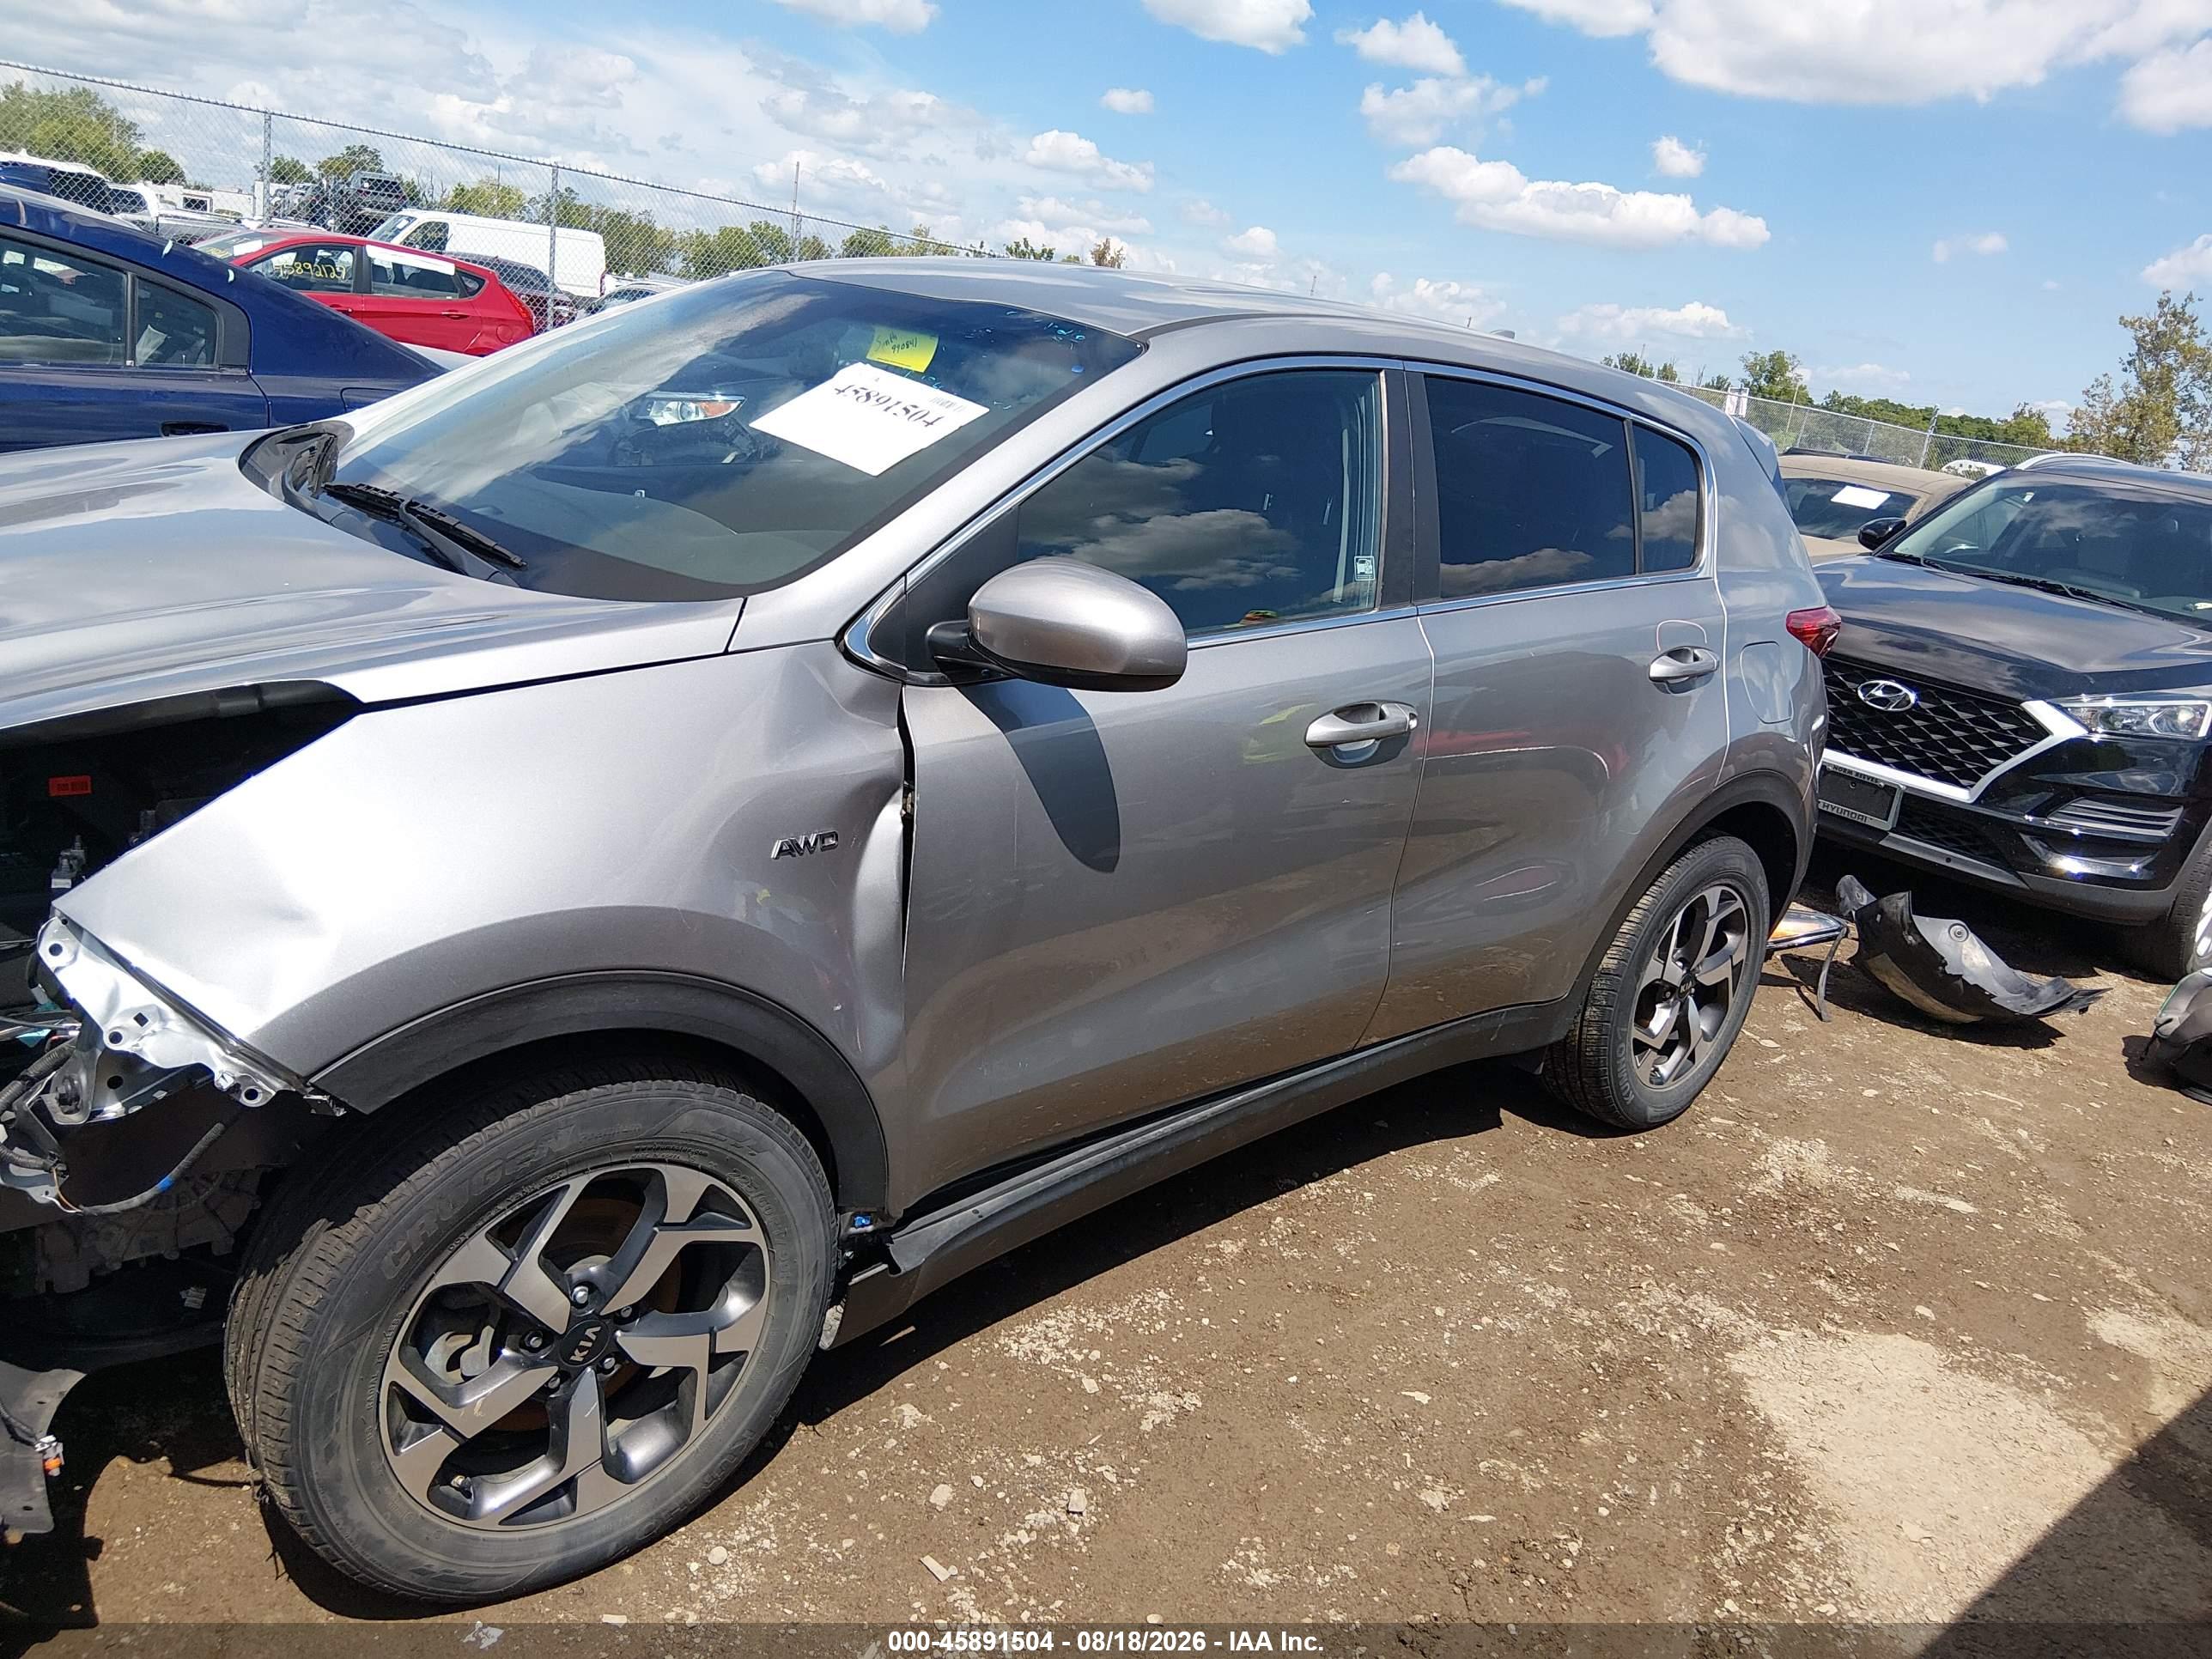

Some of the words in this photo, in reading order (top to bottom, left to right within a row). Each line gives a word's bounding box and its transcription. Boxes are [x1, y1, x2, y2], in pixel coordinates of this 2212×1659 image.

[834, 384, 945, 428] 45891504
[1821, 802, 1868, 823] HYUNDAI
[771, 830, 839, 860] AWD
[1680, 980, 1692, 994] KIA
[569, 1326, 601, 1362] KIA
